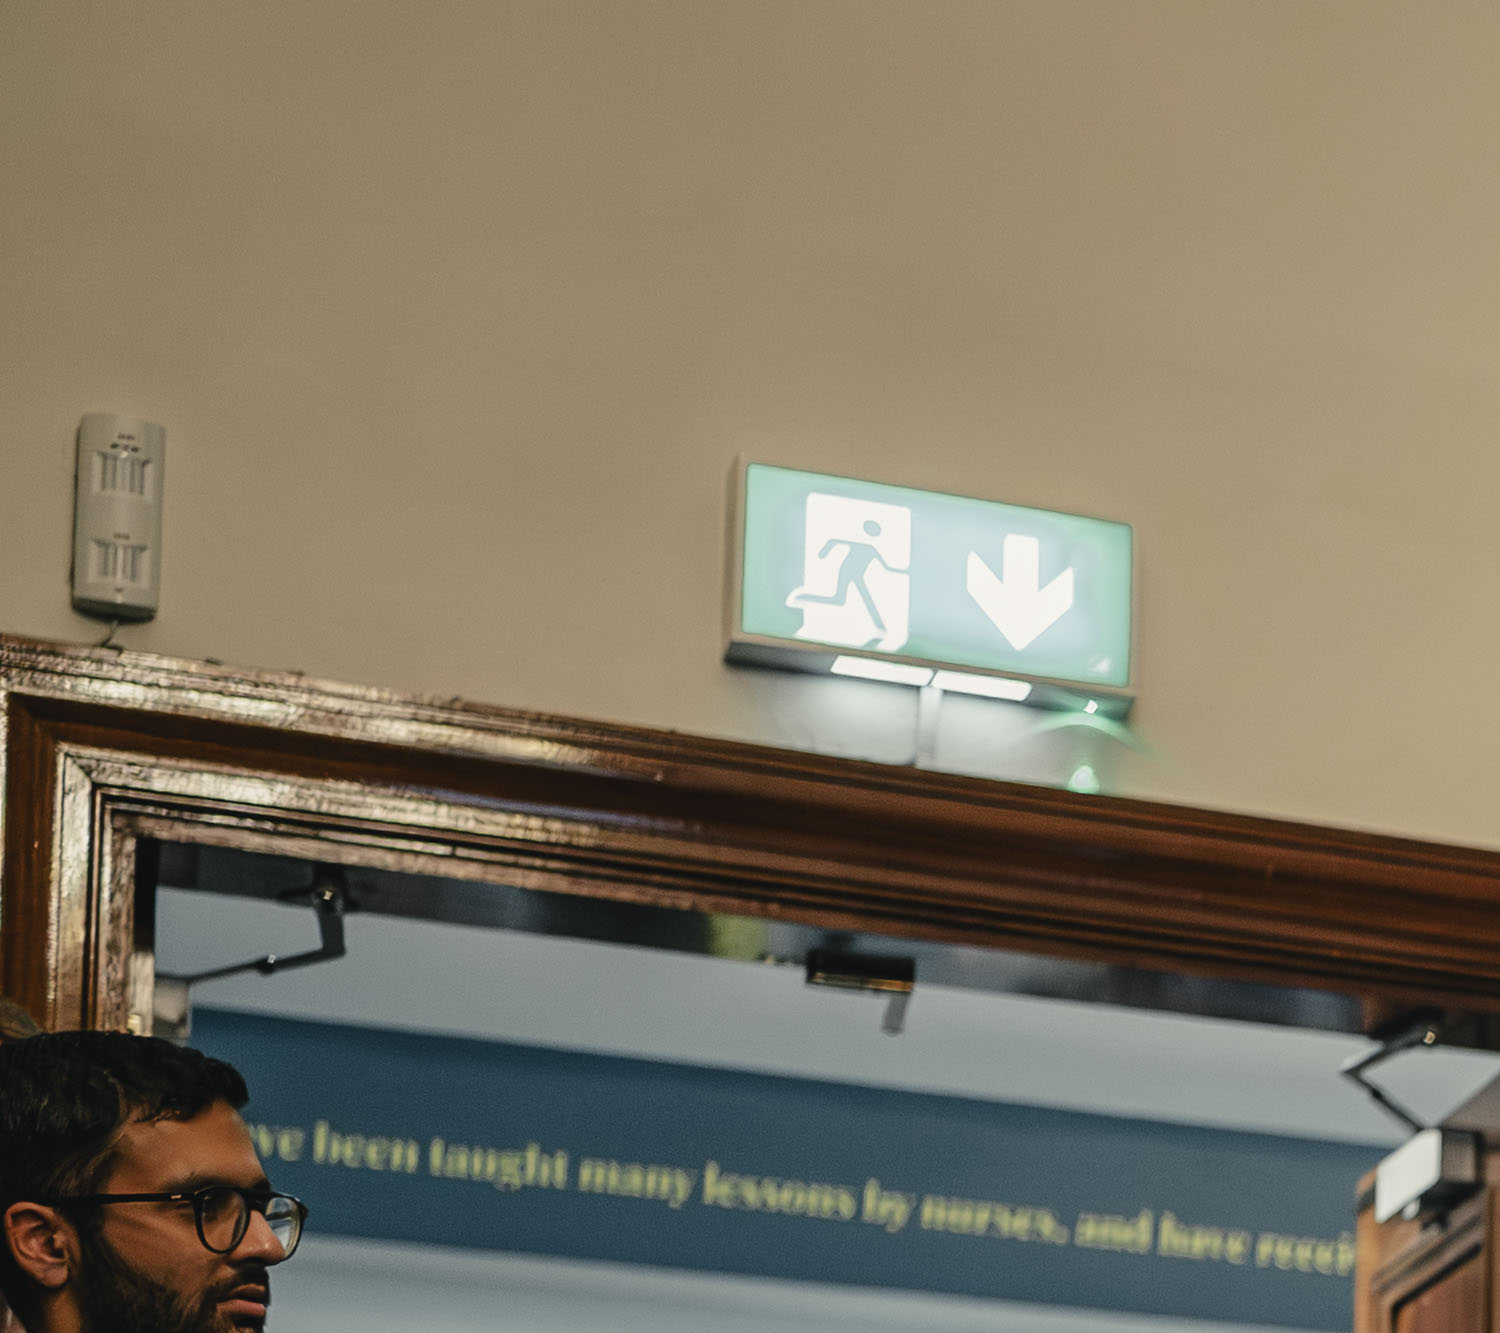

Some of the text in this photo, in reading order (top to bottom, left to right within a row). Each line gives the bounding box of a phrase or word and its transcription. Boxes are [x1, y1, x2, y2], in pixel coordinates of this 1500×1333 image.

[429, 1137, 569, 1192] taught
[578, 1157, 693, 1209] many
[862, 1177, 914, 1232] by
[1076, 1208, 1154, 1254] and
[1159, 1211, 1249, 1263] have
